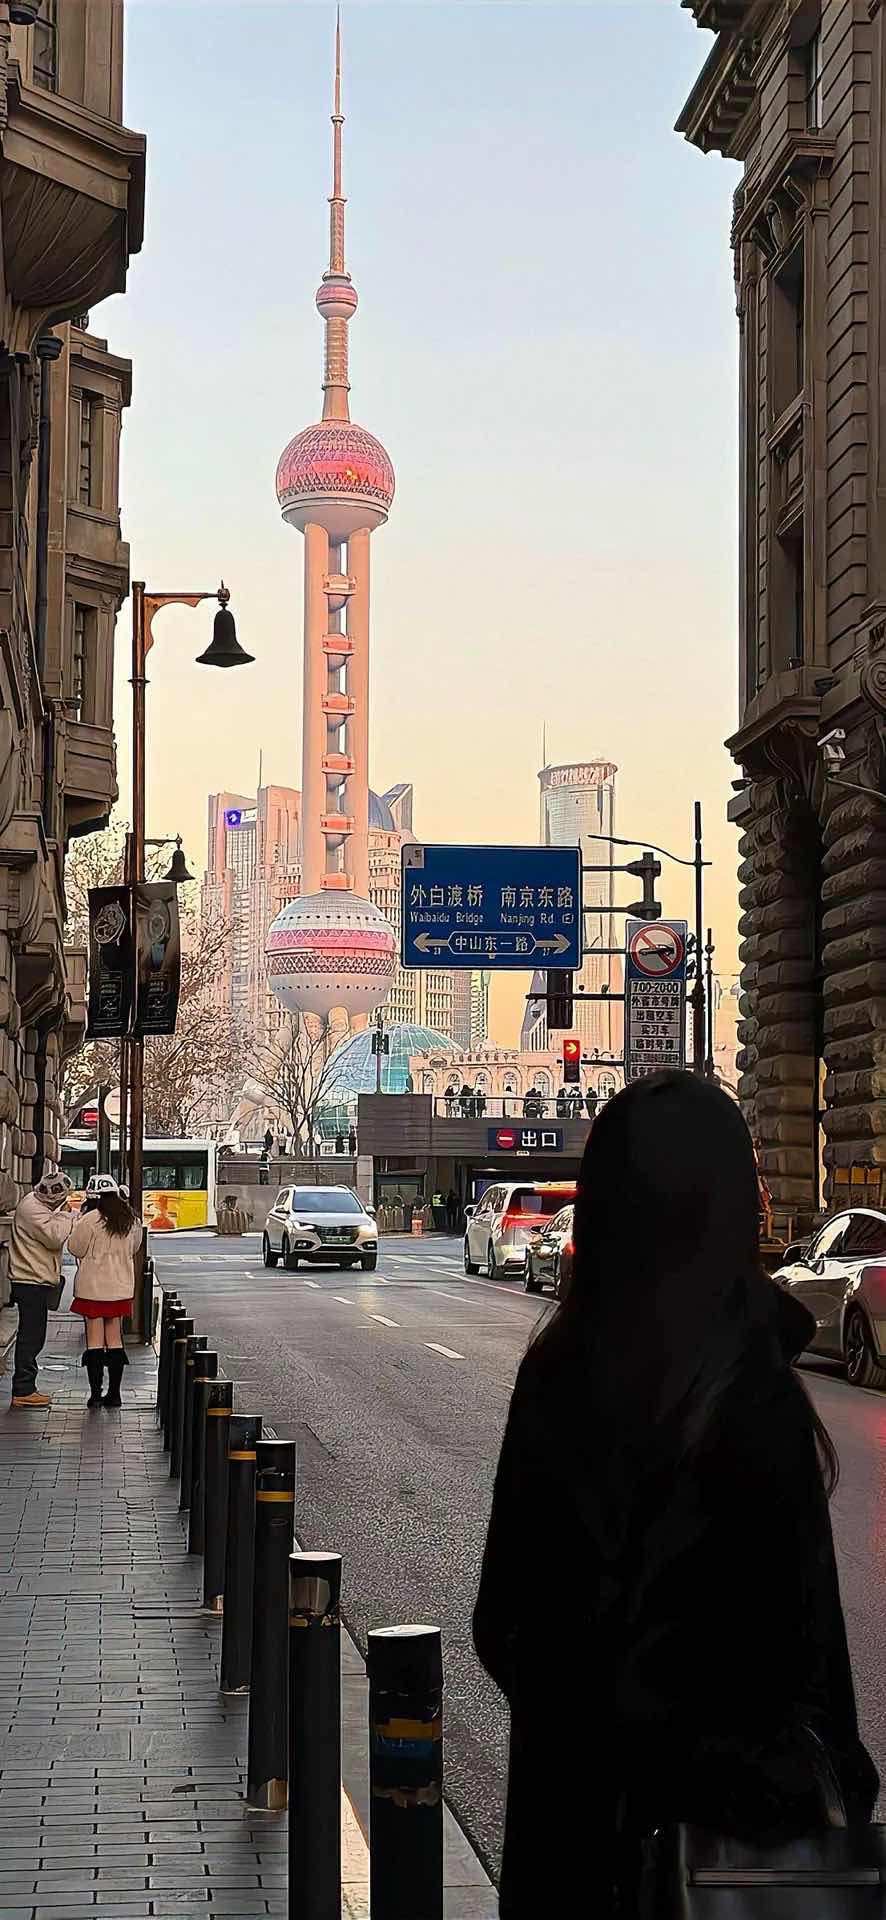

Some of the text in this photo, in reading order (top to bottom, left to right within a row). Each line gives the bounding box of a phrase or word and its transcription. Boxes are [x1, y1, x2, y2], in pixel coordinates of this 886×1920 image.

[410, 885, 484, 907] 外白渡桥
[501, 886, 574, 908] 南京东路
[410, 912, 484, 926] Waibaidu Bridge
[500, 913, 535, 927] Nanjing
[540, 913, 554, 924] Rd
[455, 935, 528, 951] 中山东一路
[641, 1024, 670, 1035] 实习车
[521, 1130, 557, 1147] 出口
